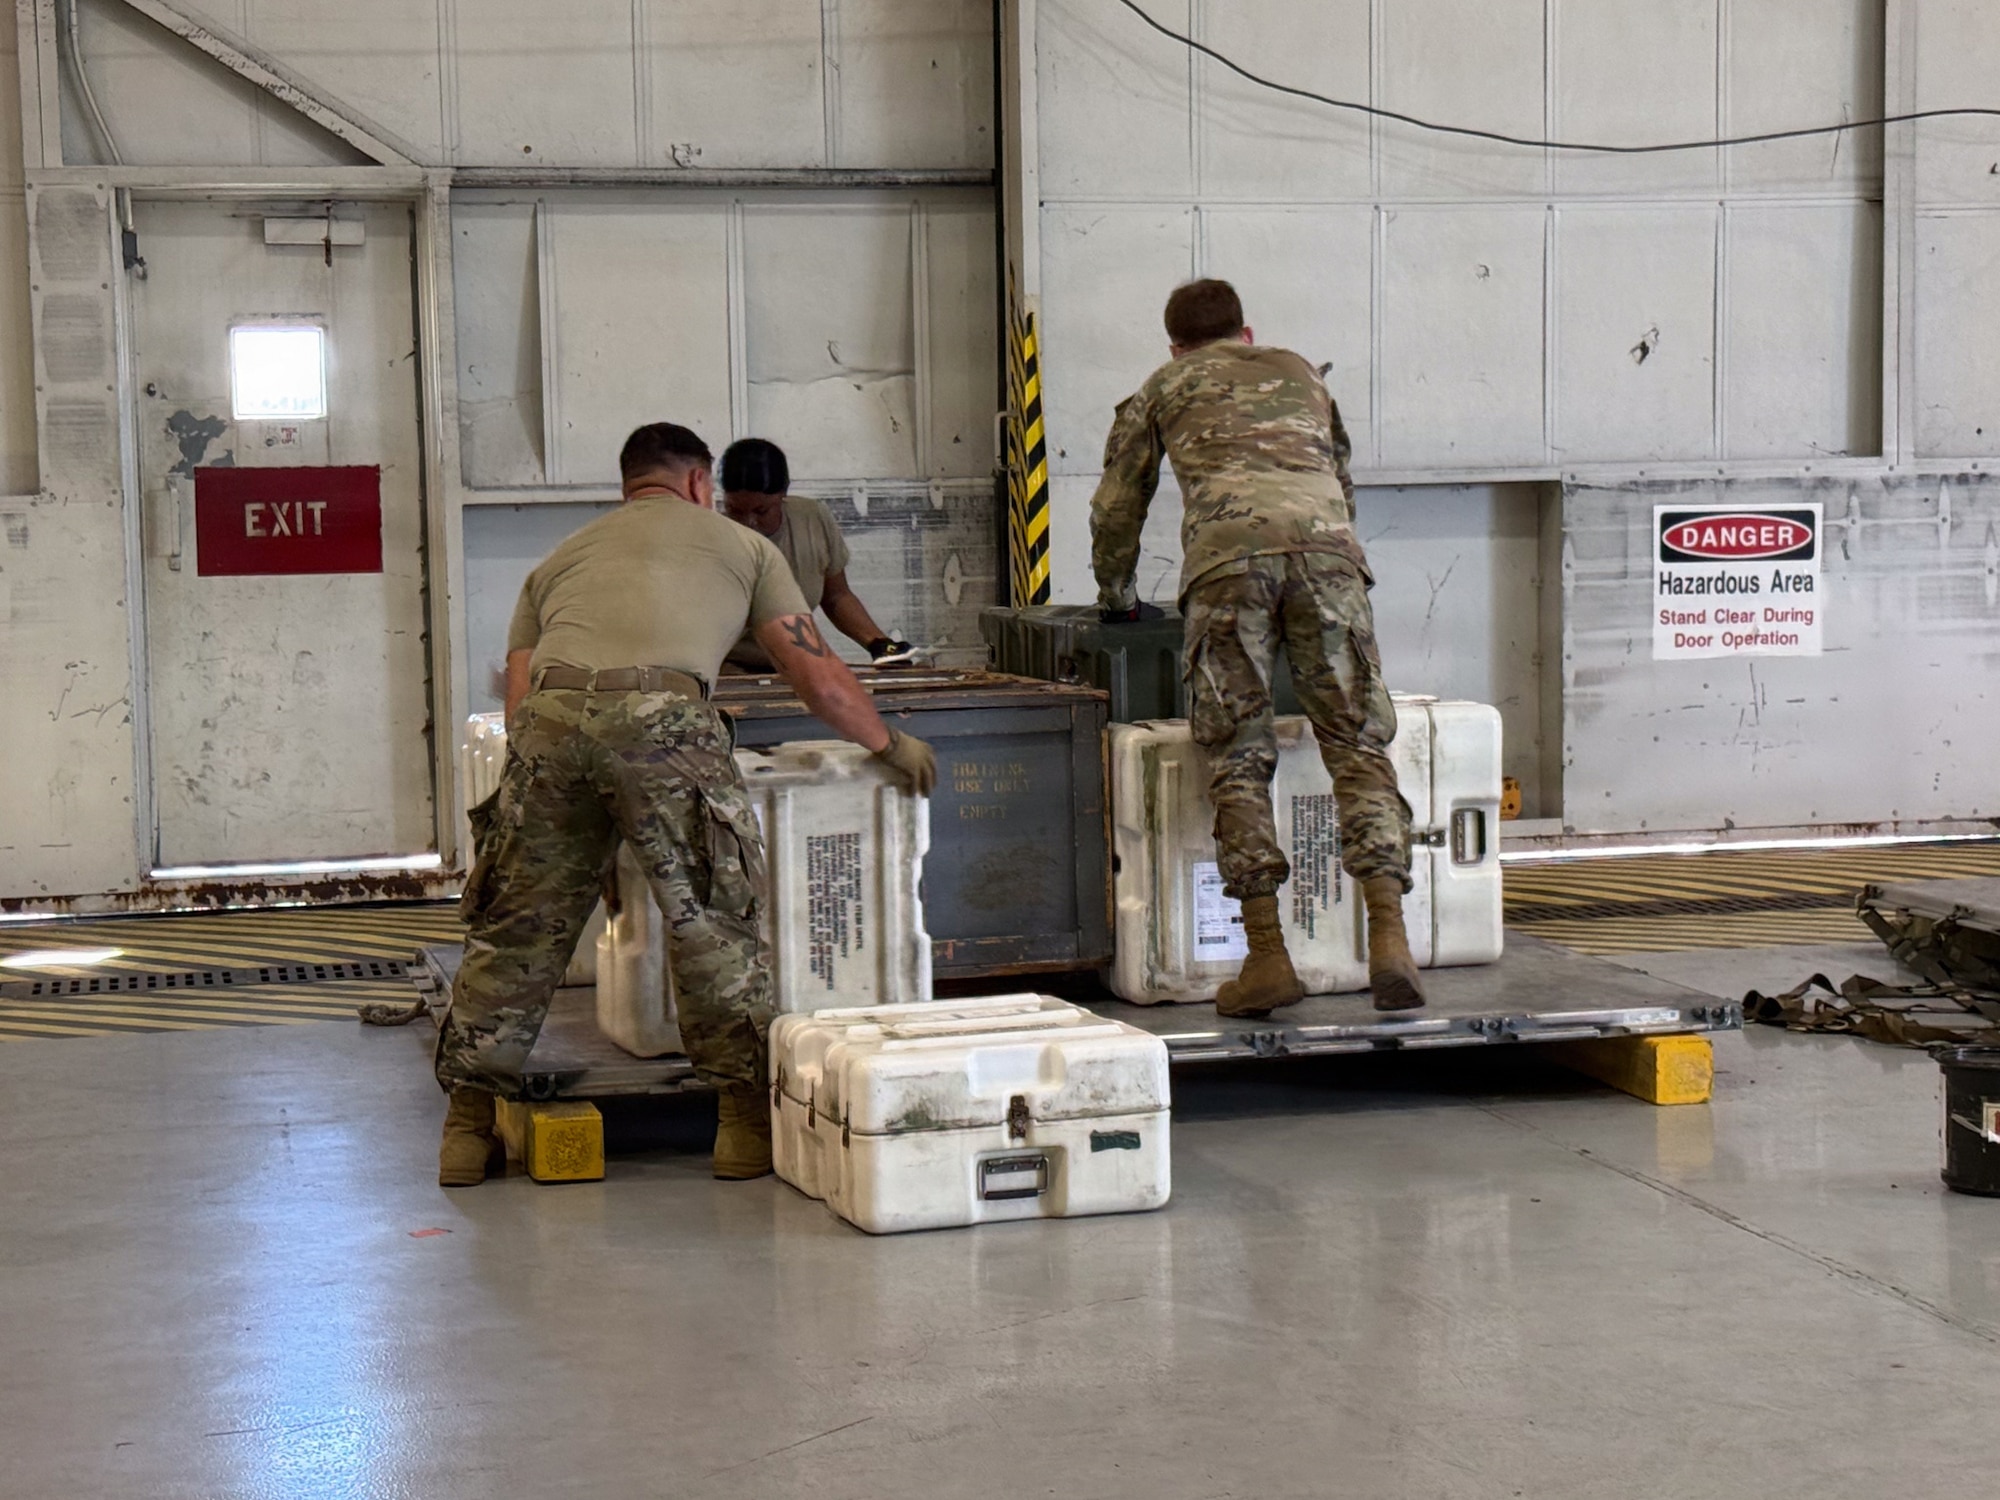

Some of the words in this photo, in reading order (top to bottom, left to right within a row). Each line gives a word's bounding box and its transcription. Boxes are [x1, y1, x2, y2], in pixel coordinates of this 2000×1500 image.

[244, 501, 328, 537] EXIT
[1681, 525, 1794, 547] DANGER
[1659, 570, 1760, 595] Hazardous
[1770, 569, 1814, 593] Area
[1659, 609, 1707, 625] Stand
[1714, 608, 1756, 624] Clear
[1763, 607, 1814, 626] During
[1674, 632, 1713, 648] Door
[1721, 631, 1799, 649] Operation
[955, 779, 984, 793] USE
[959, 804, 1008, 820] EMPTY
